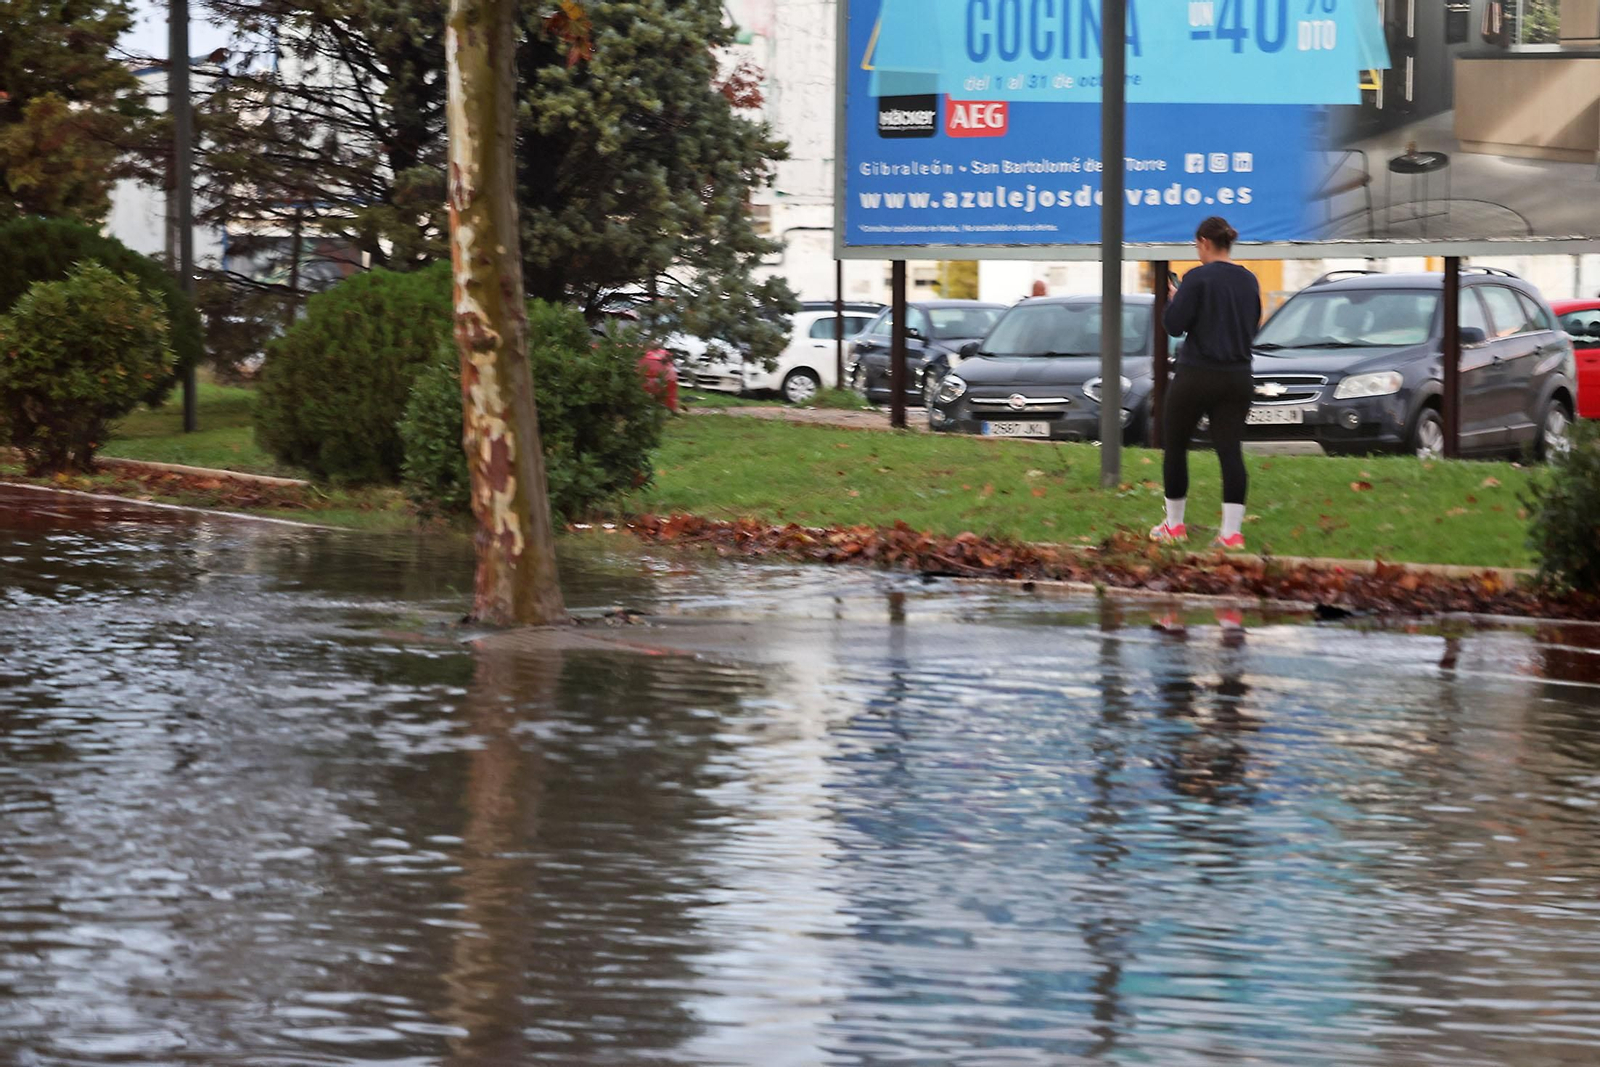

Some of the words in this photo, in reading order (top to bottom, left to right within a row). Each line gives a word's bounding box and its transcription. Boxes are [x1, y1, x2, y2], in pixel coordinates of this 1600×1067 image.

[966, 0, 1142, 63] COCINA
[964, 74, 990, 91] del
[1007, 74, 1024, 90] al
[1028, 74, 1048, 88] 31
[1053, 73, 1074, 88] de
[1078, 73, 1142, 87] octre
[949, 103, 1005, 129] AEG
[859, 160, 953, 176] Gibraleón
[971, 160, 999, 174] San
[1002, 158, 1081, 174] Bartolomé
[1083, 157, 1103, 173] de
[1124, 157, 1167, 171] Torre
[859, 183, 1253, 213] www.azulejosdvado.es
